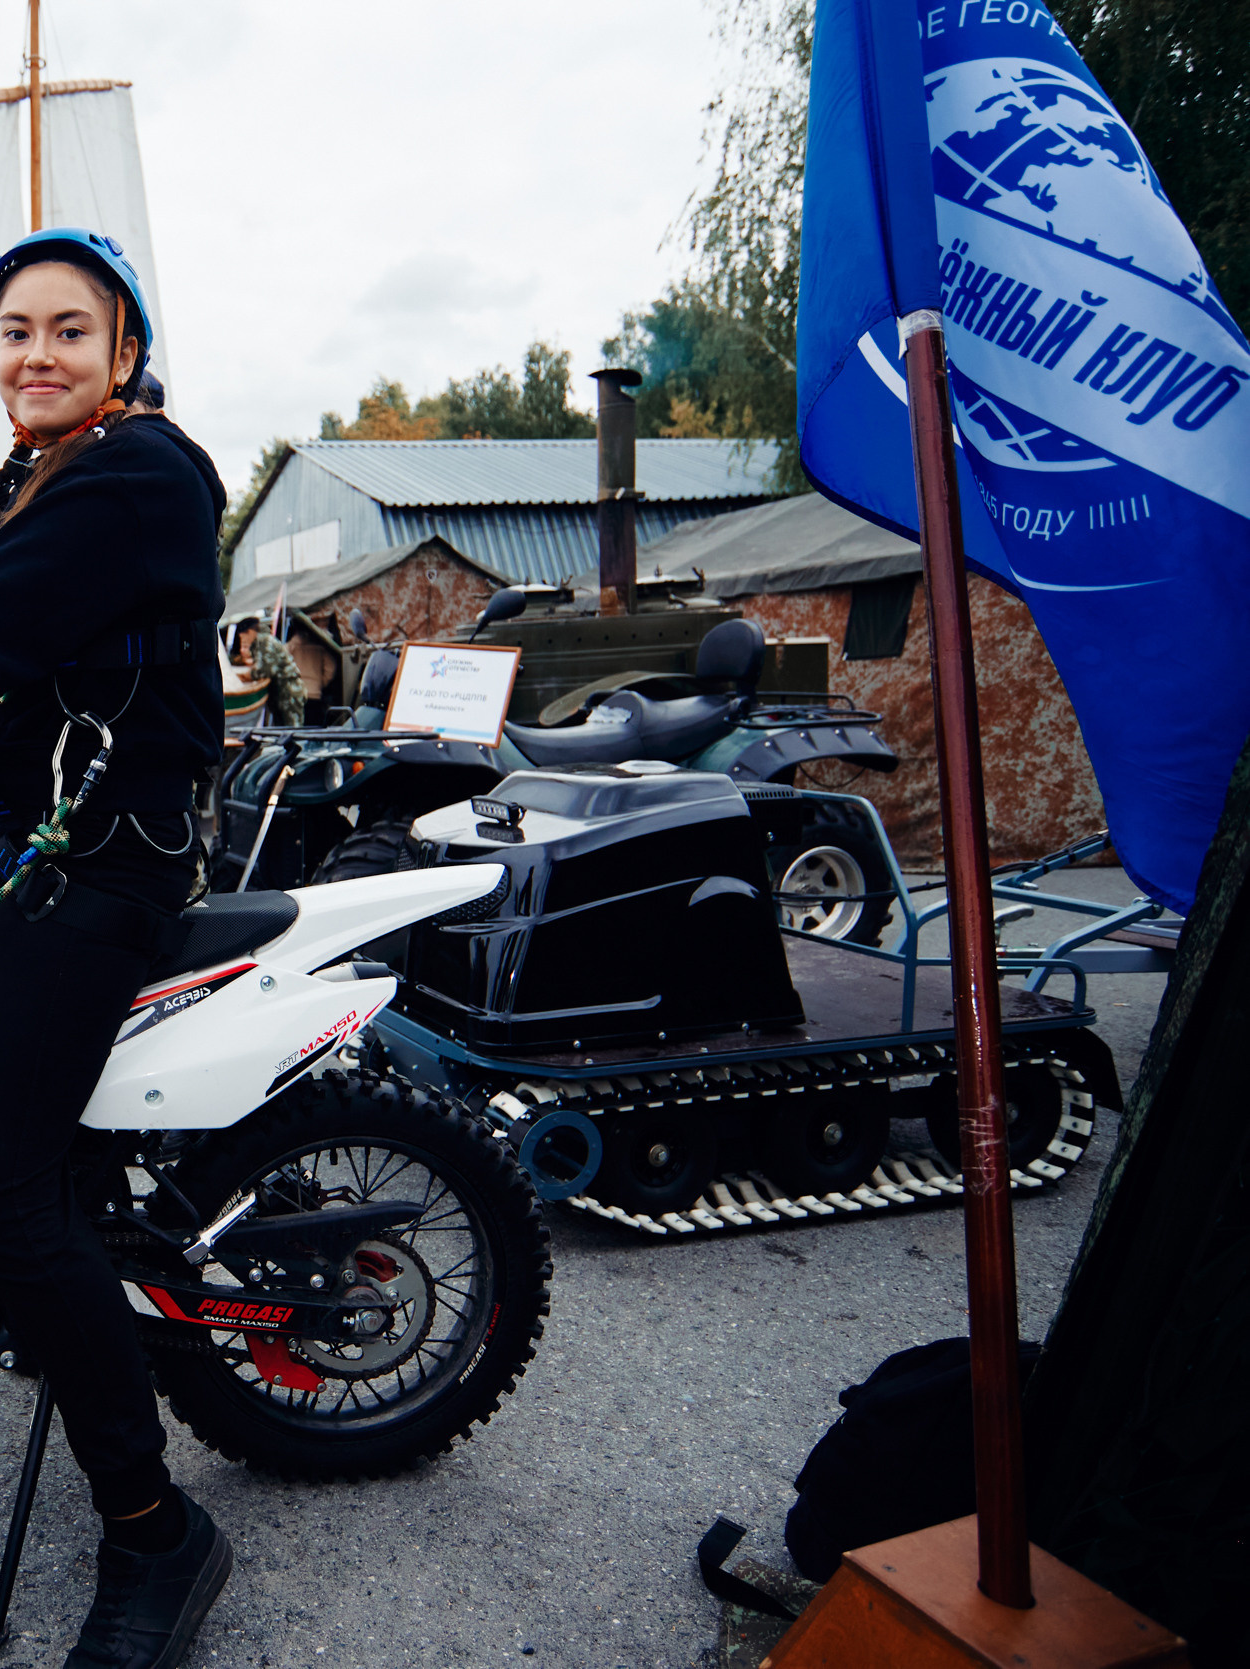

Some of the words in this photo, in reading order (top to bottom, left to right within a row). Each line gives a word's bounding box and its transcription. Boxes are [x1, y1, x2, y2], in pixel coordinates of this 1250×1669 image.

[937, 238, 1109, 371] ЁЖНЫЙ
[1002, 503, 1076, 541] ГОДУ
[196, 1298, 295, 1323] PROGASI
[202, 1314, 239, 1325] SMART
[458, 1342, 487, 1385] PROGASI
